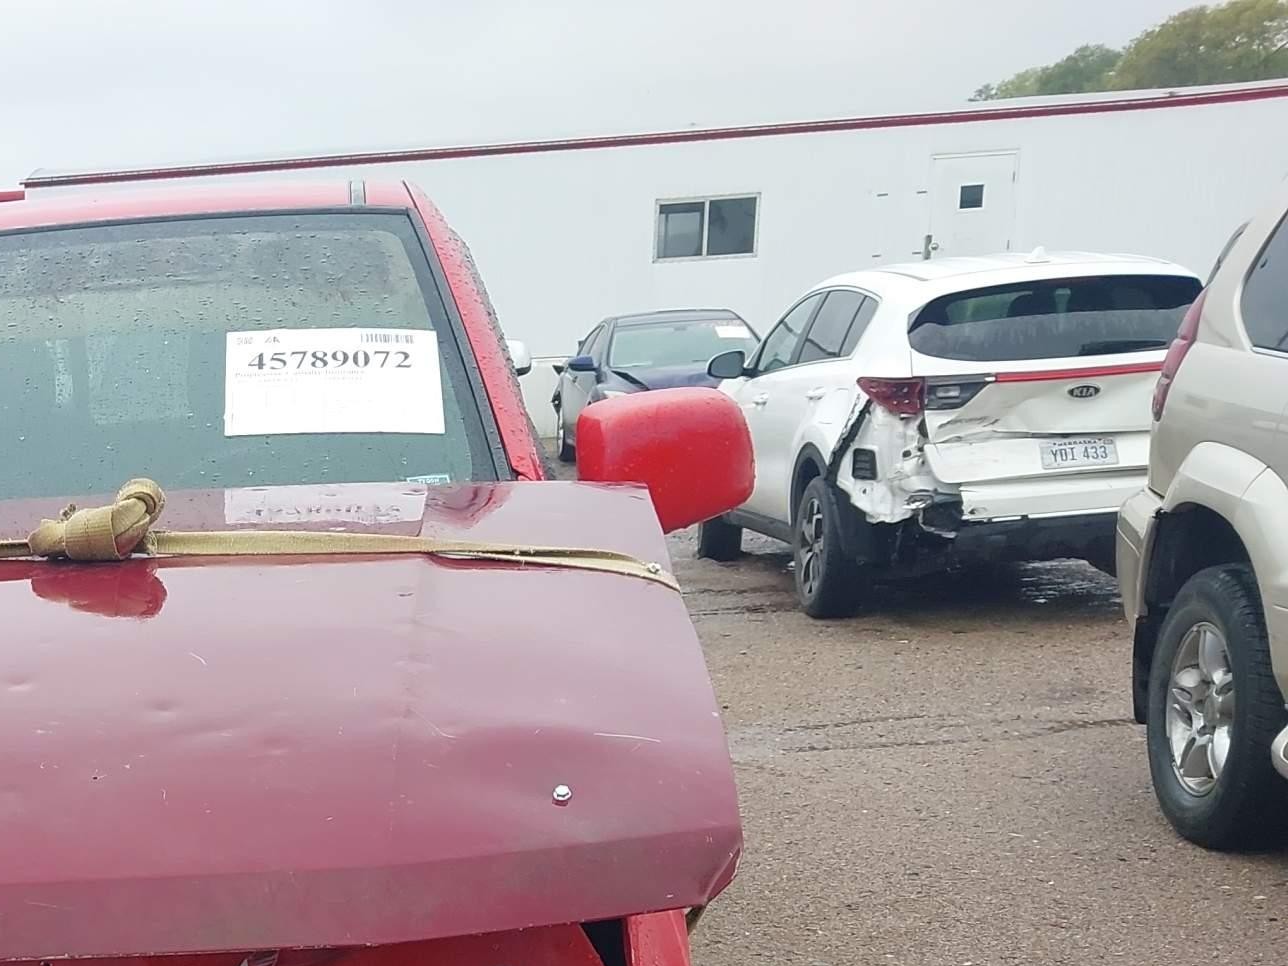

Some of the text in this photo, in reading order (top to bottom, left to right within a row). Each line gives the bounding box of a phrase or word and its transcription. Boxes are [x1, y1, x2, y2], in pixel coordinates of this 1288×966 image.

[247, 350, 412, 370] 45789072
[1073, 387, 1096, 396] KIA
[1083, 445, 1108, 460] 433
